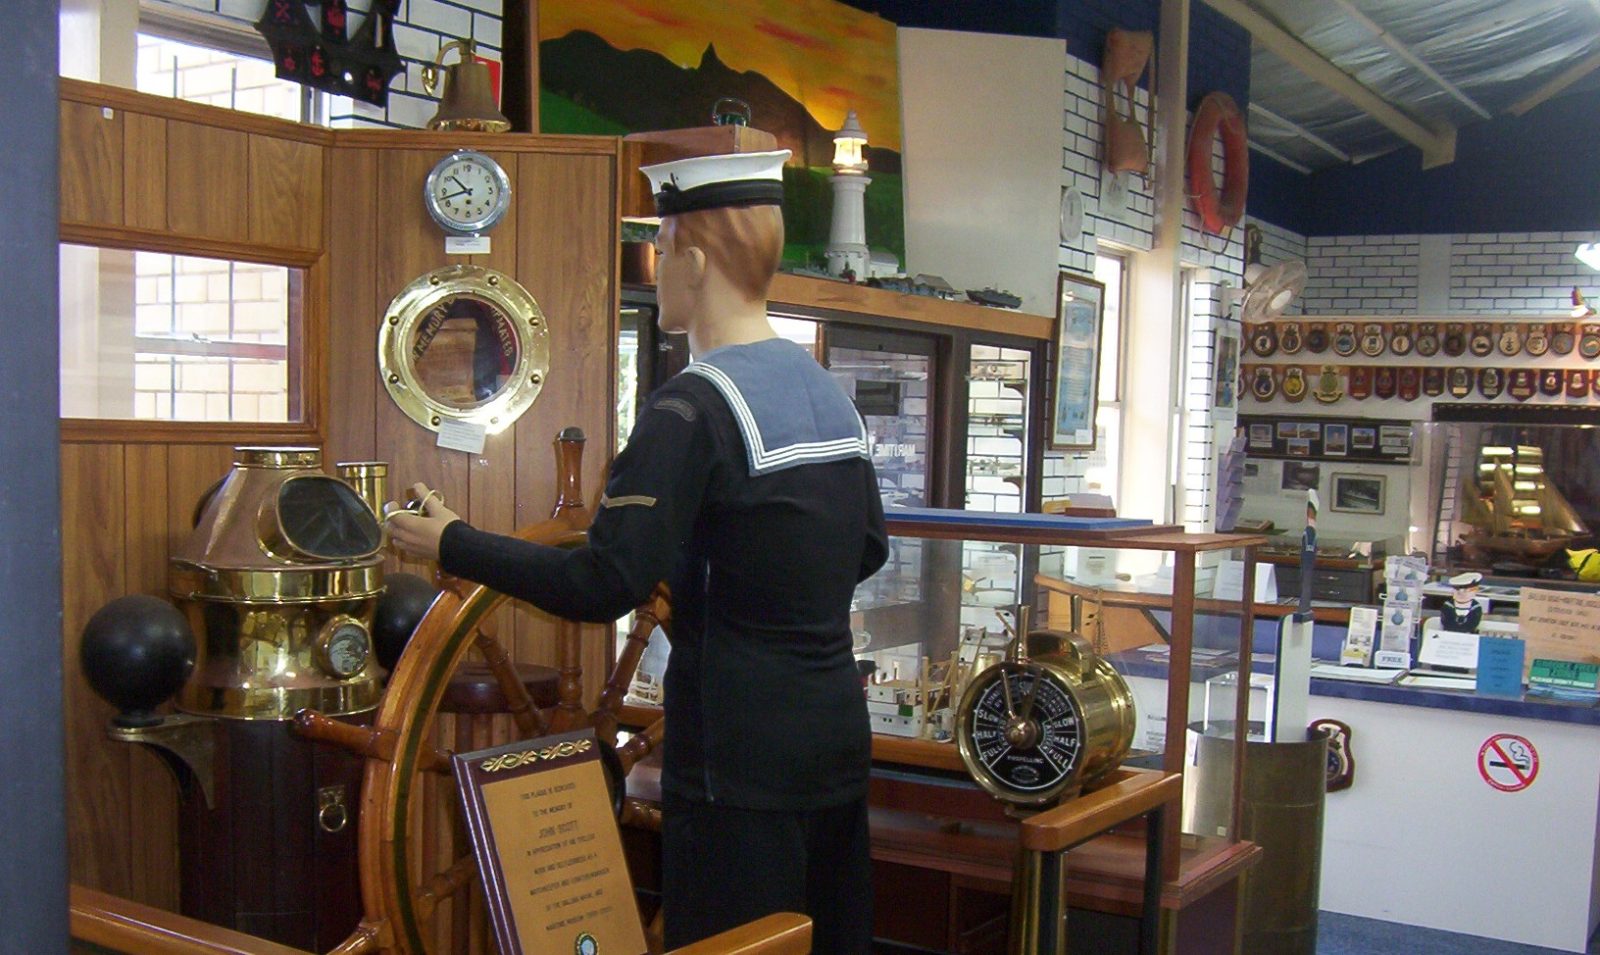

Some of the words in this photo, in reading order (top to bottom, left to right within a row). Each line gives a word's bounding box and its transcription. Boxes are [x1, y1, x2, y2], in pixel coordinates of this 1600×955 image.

[419, 304, 449, 356] MEMORY
[978, 708, 999, 723] SLOW
[1052, 717, 1075, 729] SLOW
[976, 730, 997, 740] HALF
[1053, 736, 1076, 747] HALF
[981, 745, 1002, 761] FULL
[1048, 748, 1069, 769] FULL
